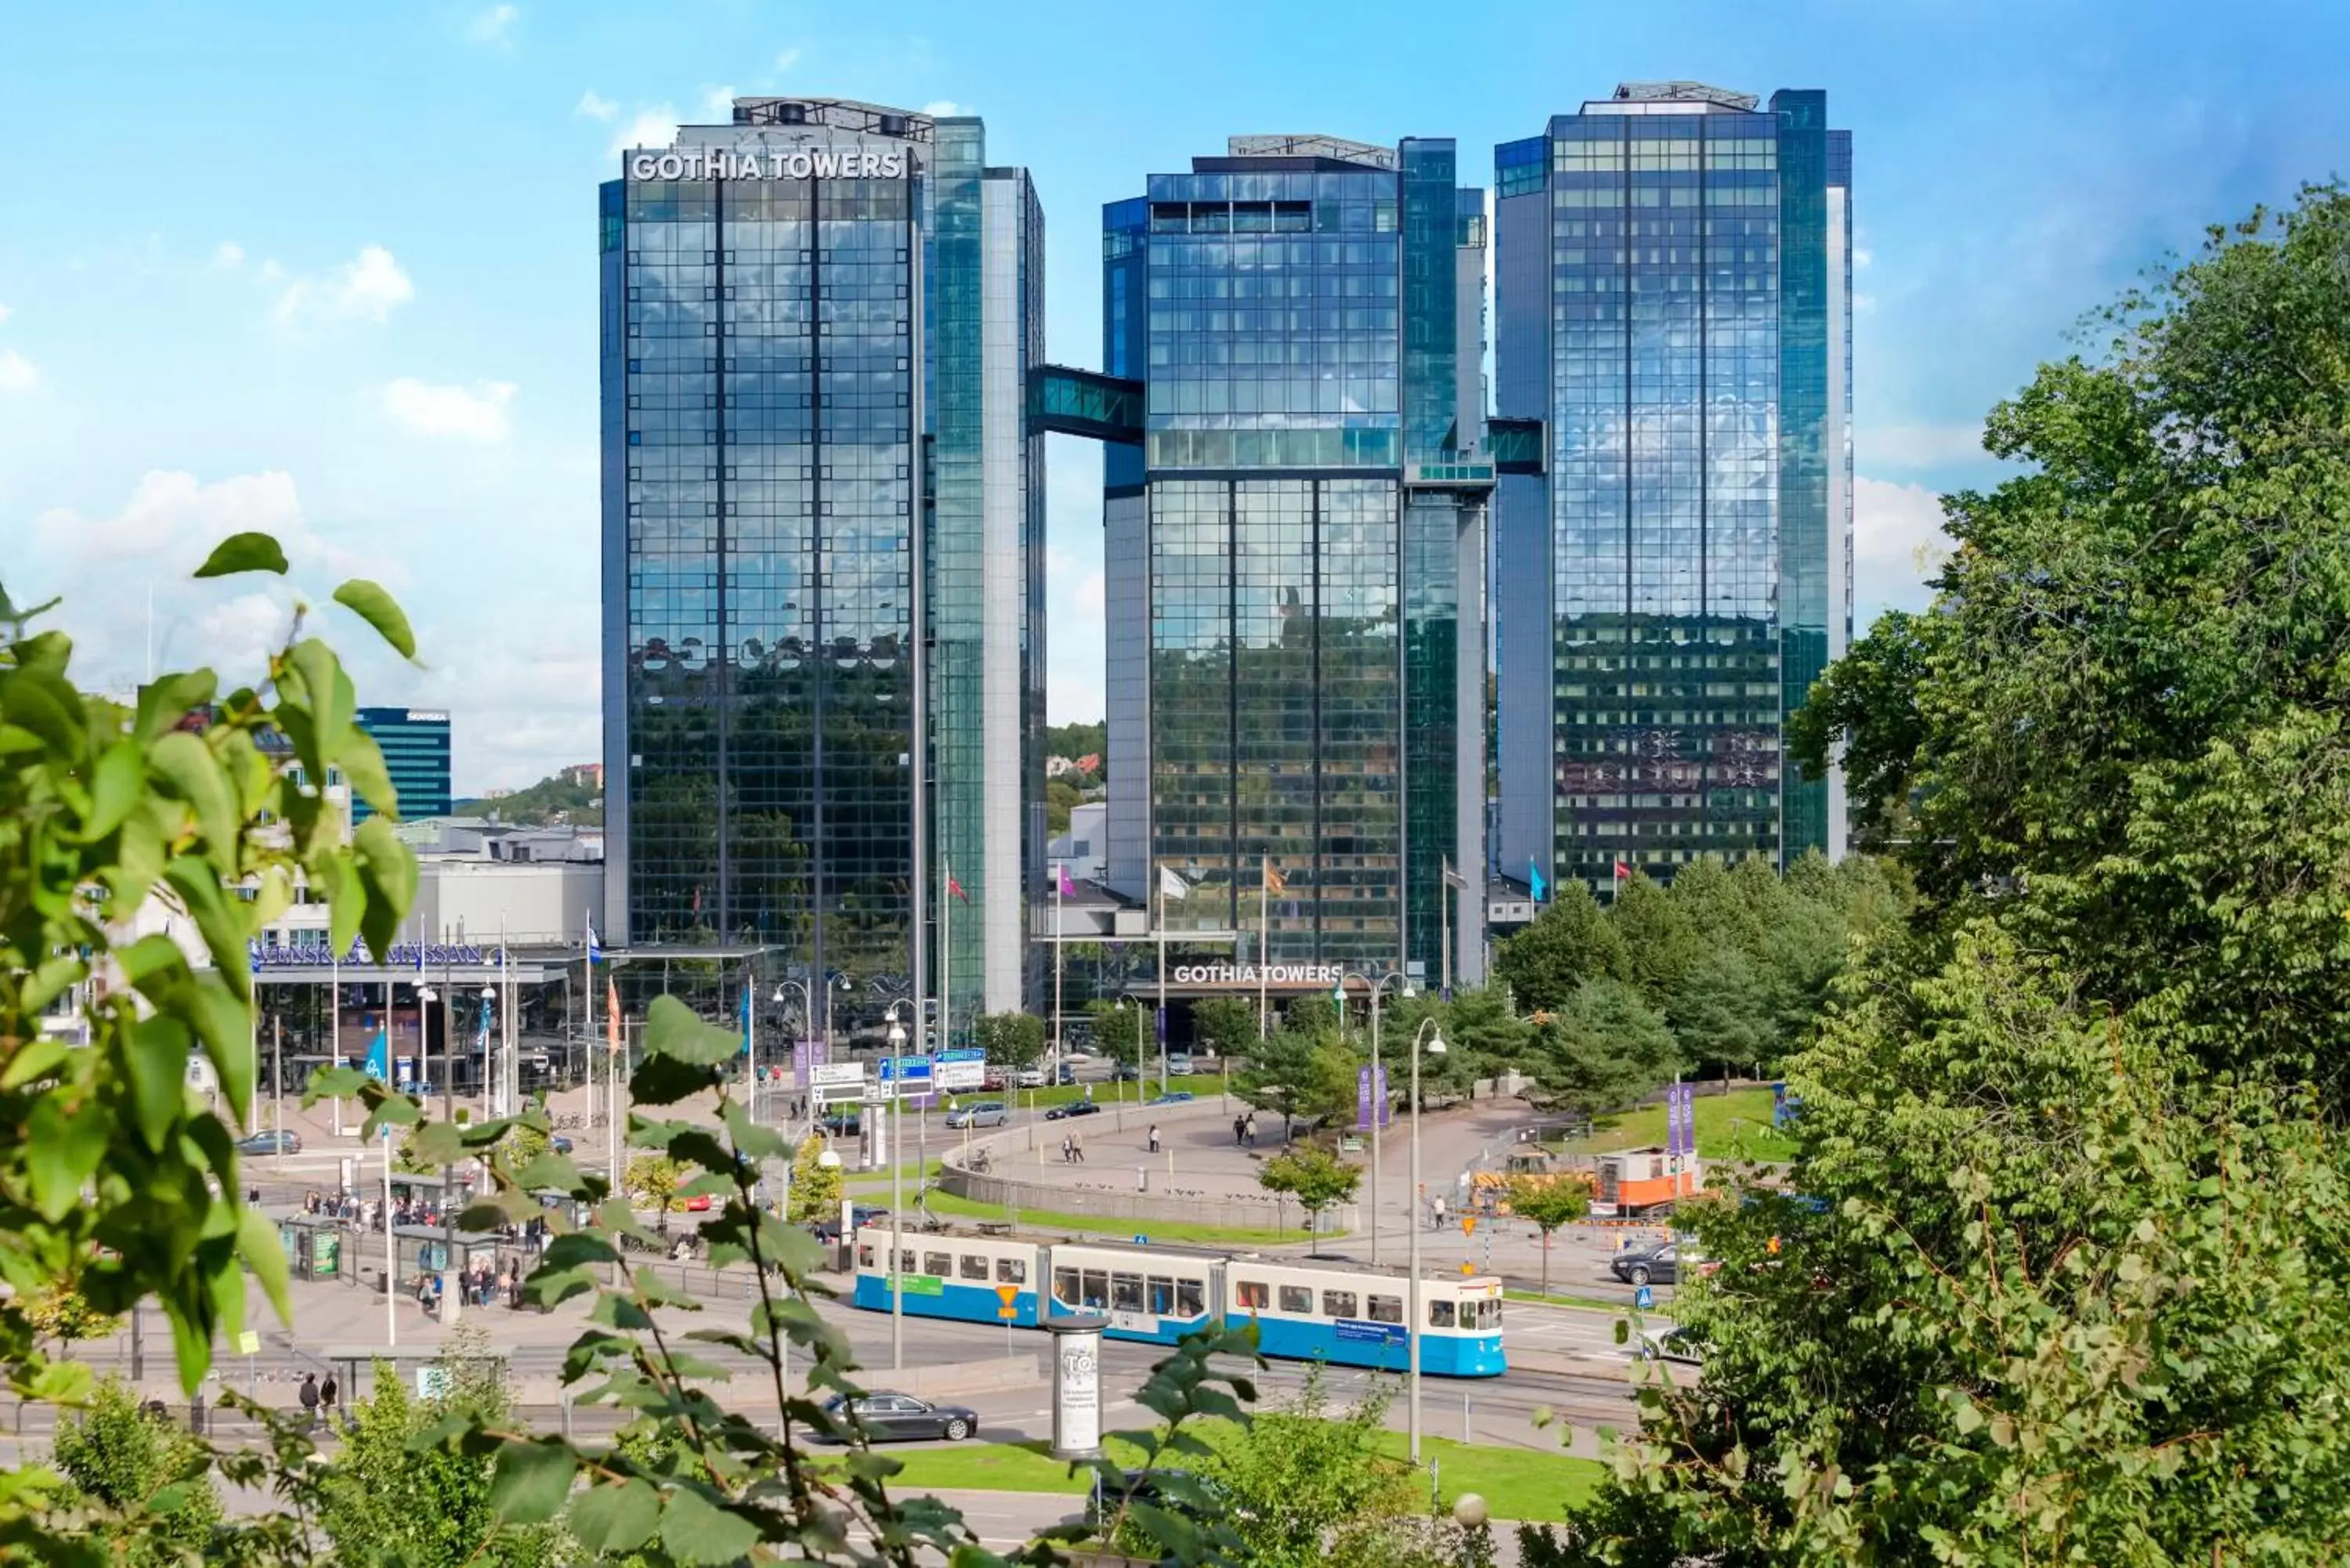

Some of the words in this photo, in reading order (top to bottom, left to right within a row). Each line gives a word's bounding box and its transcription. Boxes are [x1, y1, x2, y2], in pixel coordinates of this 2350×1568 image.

[632, 153, 761, 180] GOTHIA
[774, 152, 902, 180] TOWERS
[1173, 965, 1256, 983] GOTHIA
[1259, 964, 1342, 983] TOWERS
